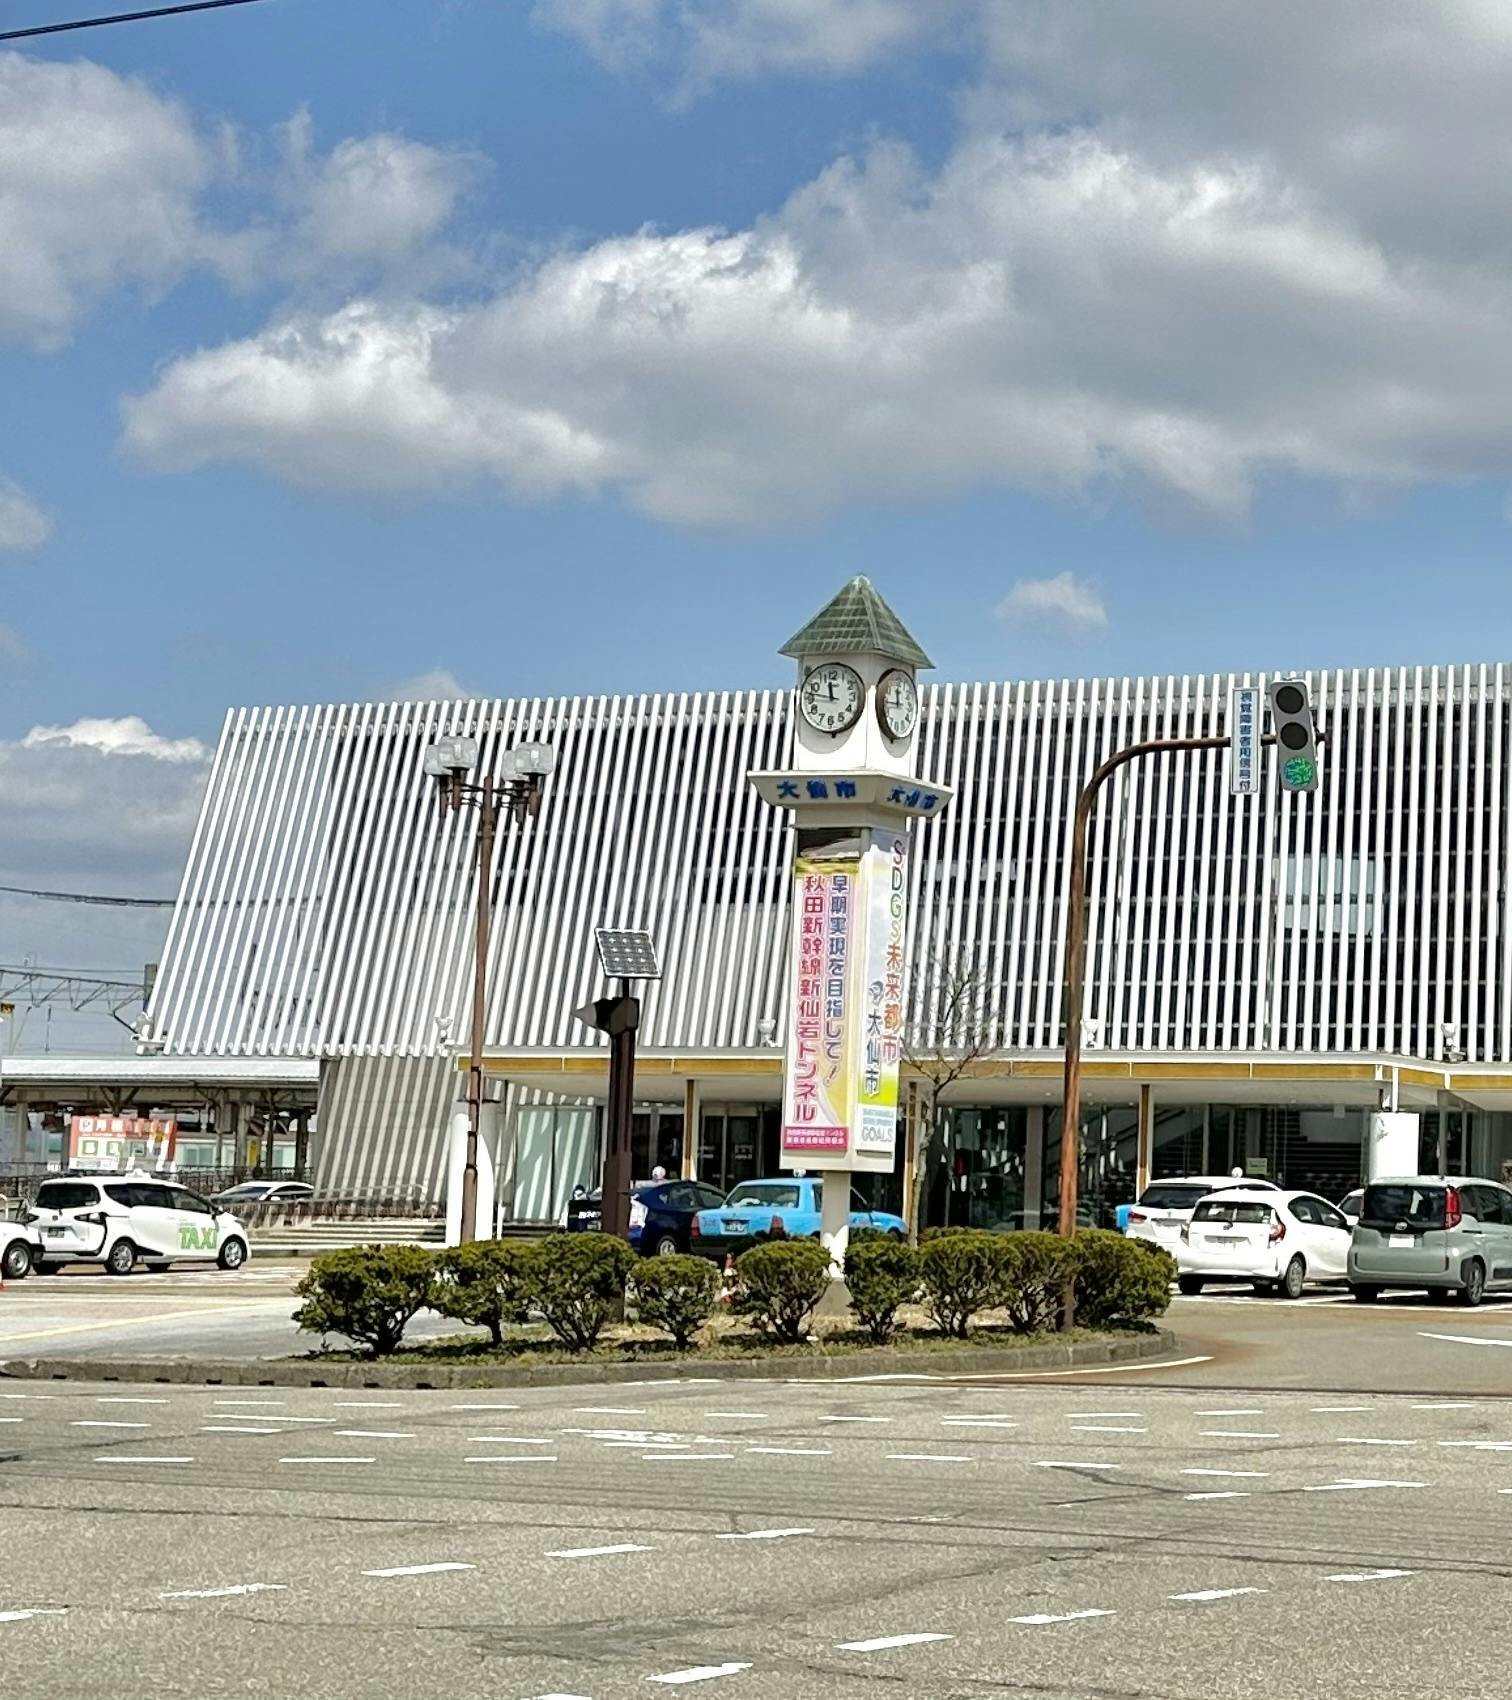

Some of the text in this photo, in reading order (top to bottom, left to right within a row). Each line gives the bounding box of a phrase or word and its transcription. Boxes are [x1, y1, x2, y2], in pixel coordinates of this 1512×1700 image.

[776, 780, 857, 799] 大仙市
[795, 875, 825, 1122] 秋田新幹線新仙岩トンネル
[865, 1011, 881, 1095] 大仙市
[862, 1127, 894, 1142] GOALS
[178, 1227, 218, 1250] TAXI
